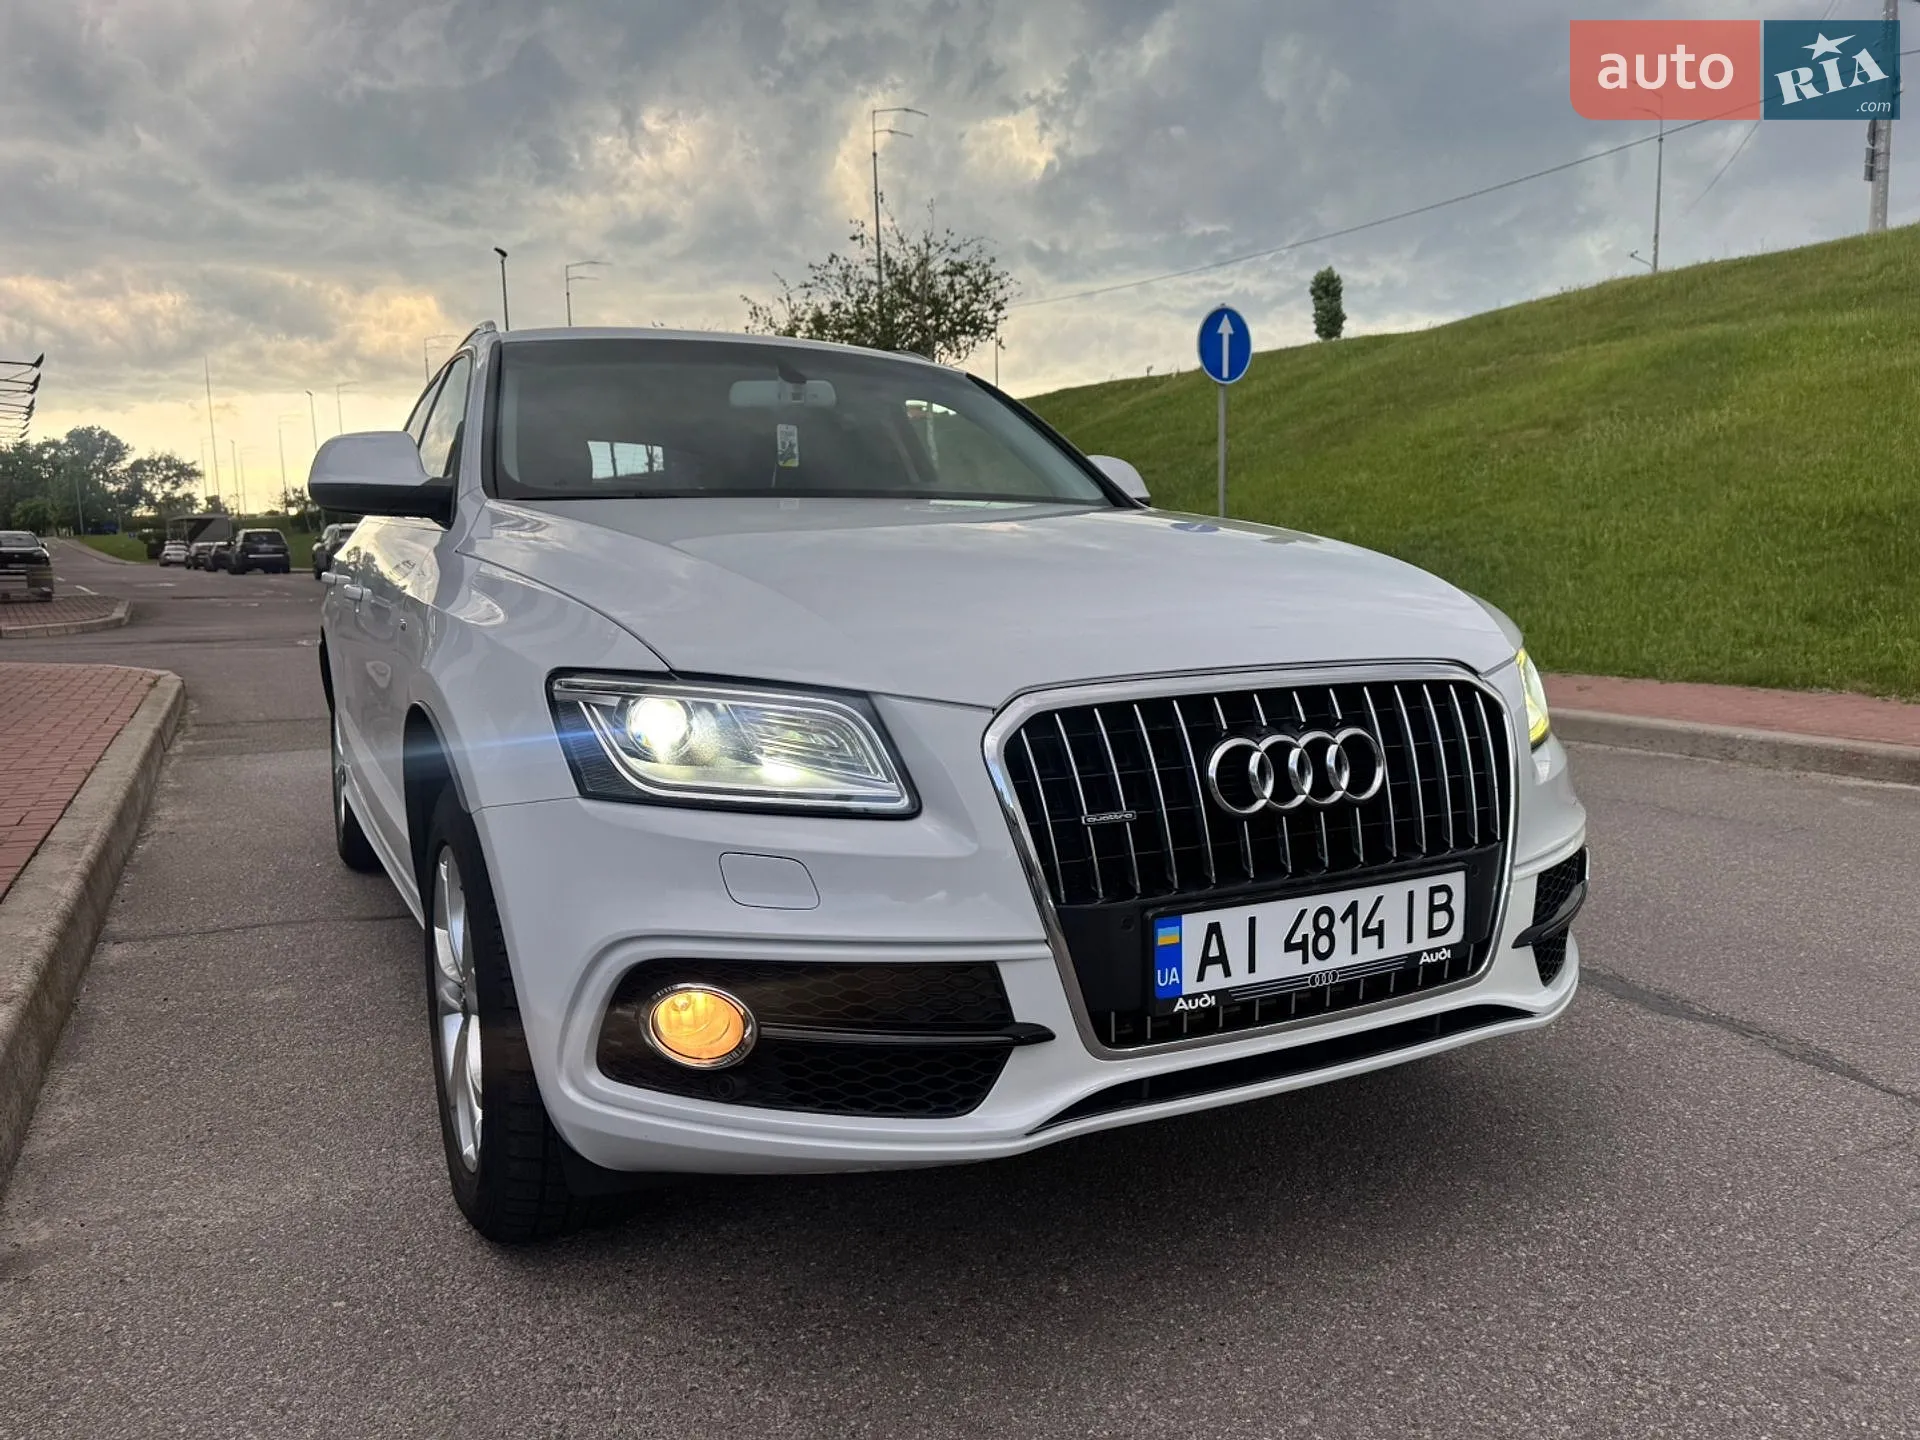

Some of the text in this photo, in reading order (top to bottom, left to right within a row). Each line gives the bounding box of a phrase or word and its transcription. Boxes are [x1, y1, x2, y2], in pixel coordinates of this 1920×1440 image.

[1196, 883, 1455, 983] AI 4814 IB
[1418, 949, 1452, 966] Audi
[1157, 967, 1180, 987] UA
[1173, 995, 1216, 1012] Audi
